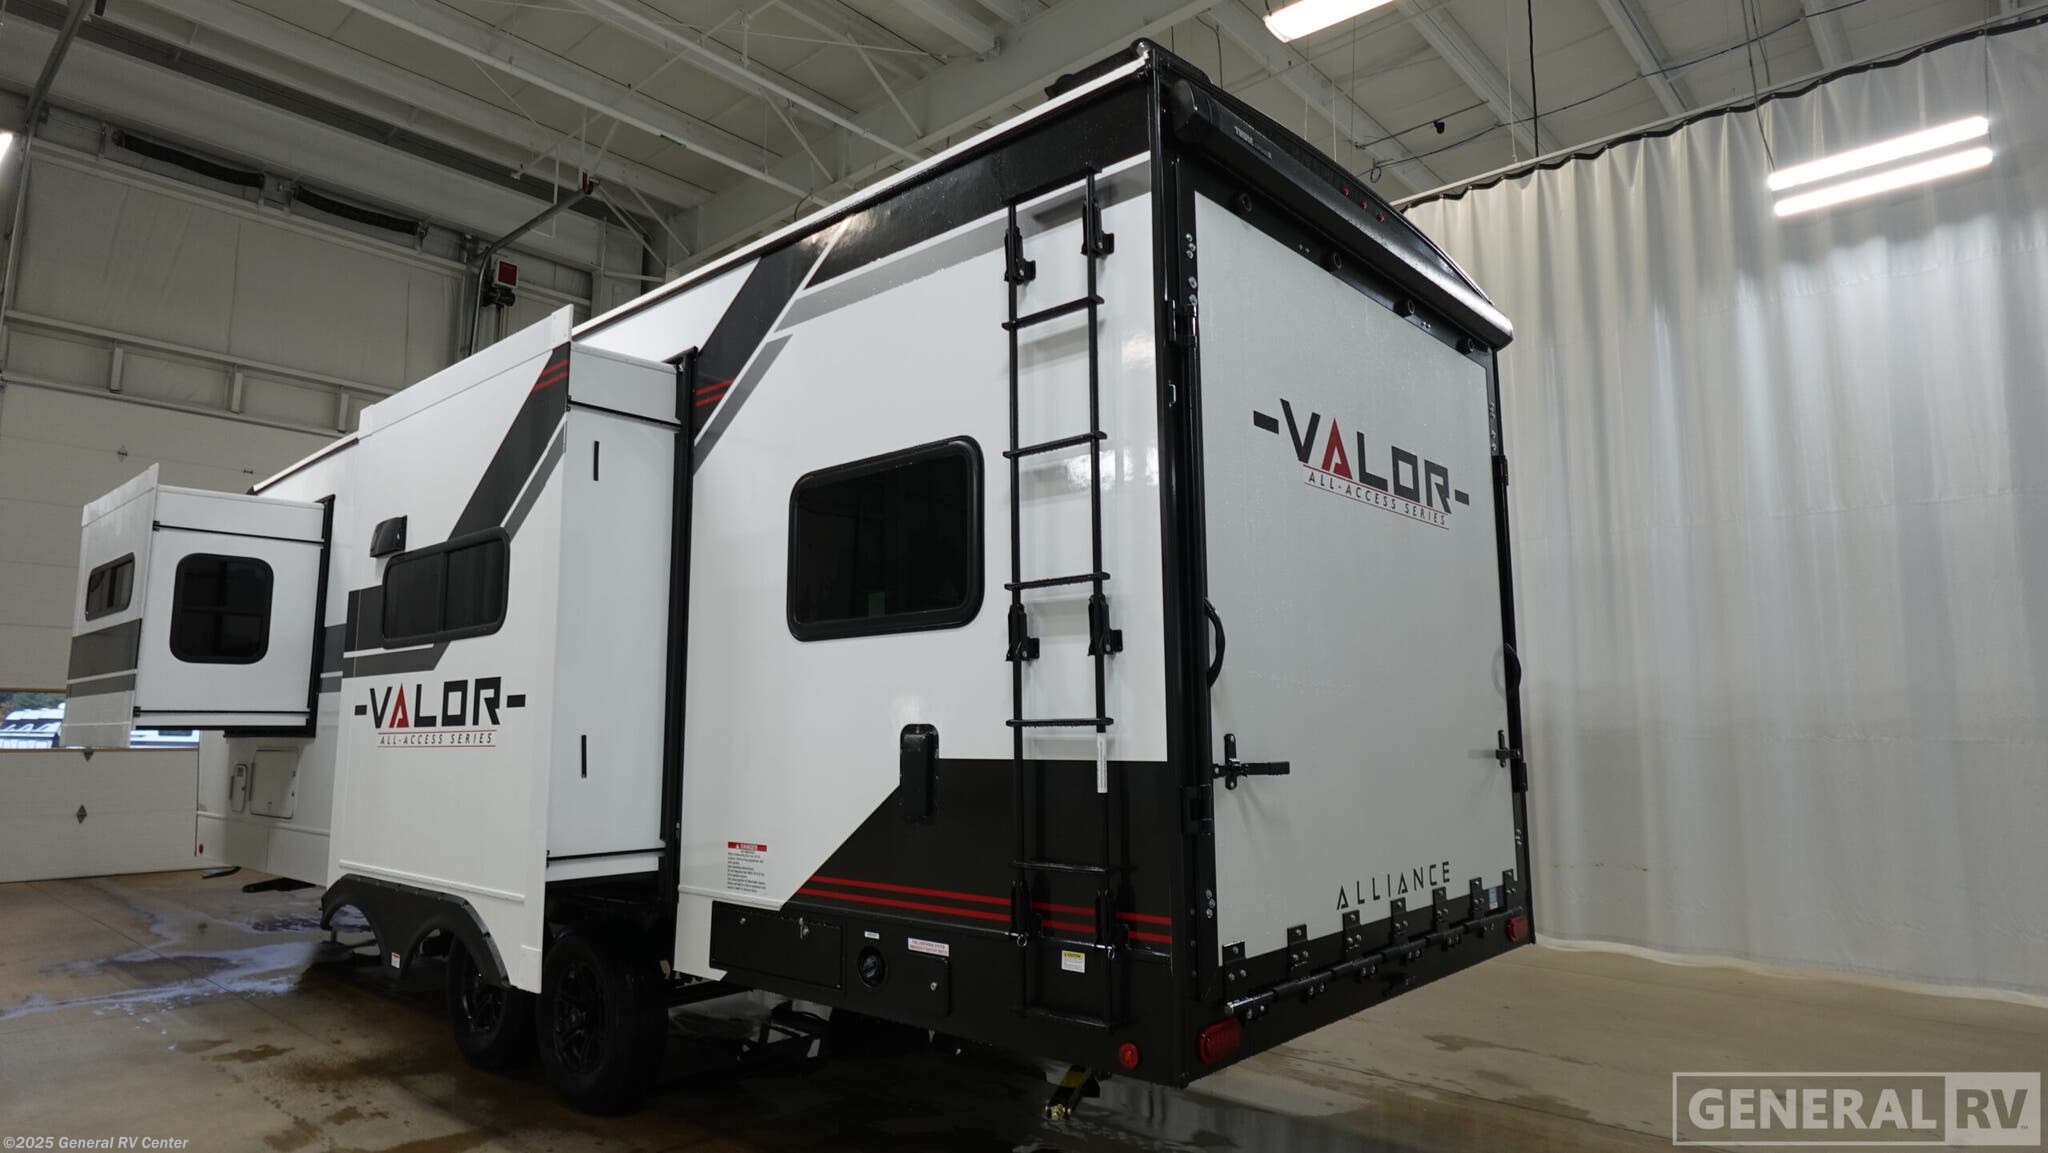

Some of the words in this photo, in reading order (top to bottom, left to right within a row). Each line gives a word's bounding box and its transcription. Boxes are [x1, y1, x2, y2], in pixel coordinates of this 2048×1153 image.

[1308, 471, 1397, 510] ALL-ACCESS
[1404, 503, 1446, 526] SERIES
[380, 734, 443, 745] ALL-ACCESS
[450, 732, 492, 744] SERIES
[1336, 861, 1450, 911] ALLIANCE
